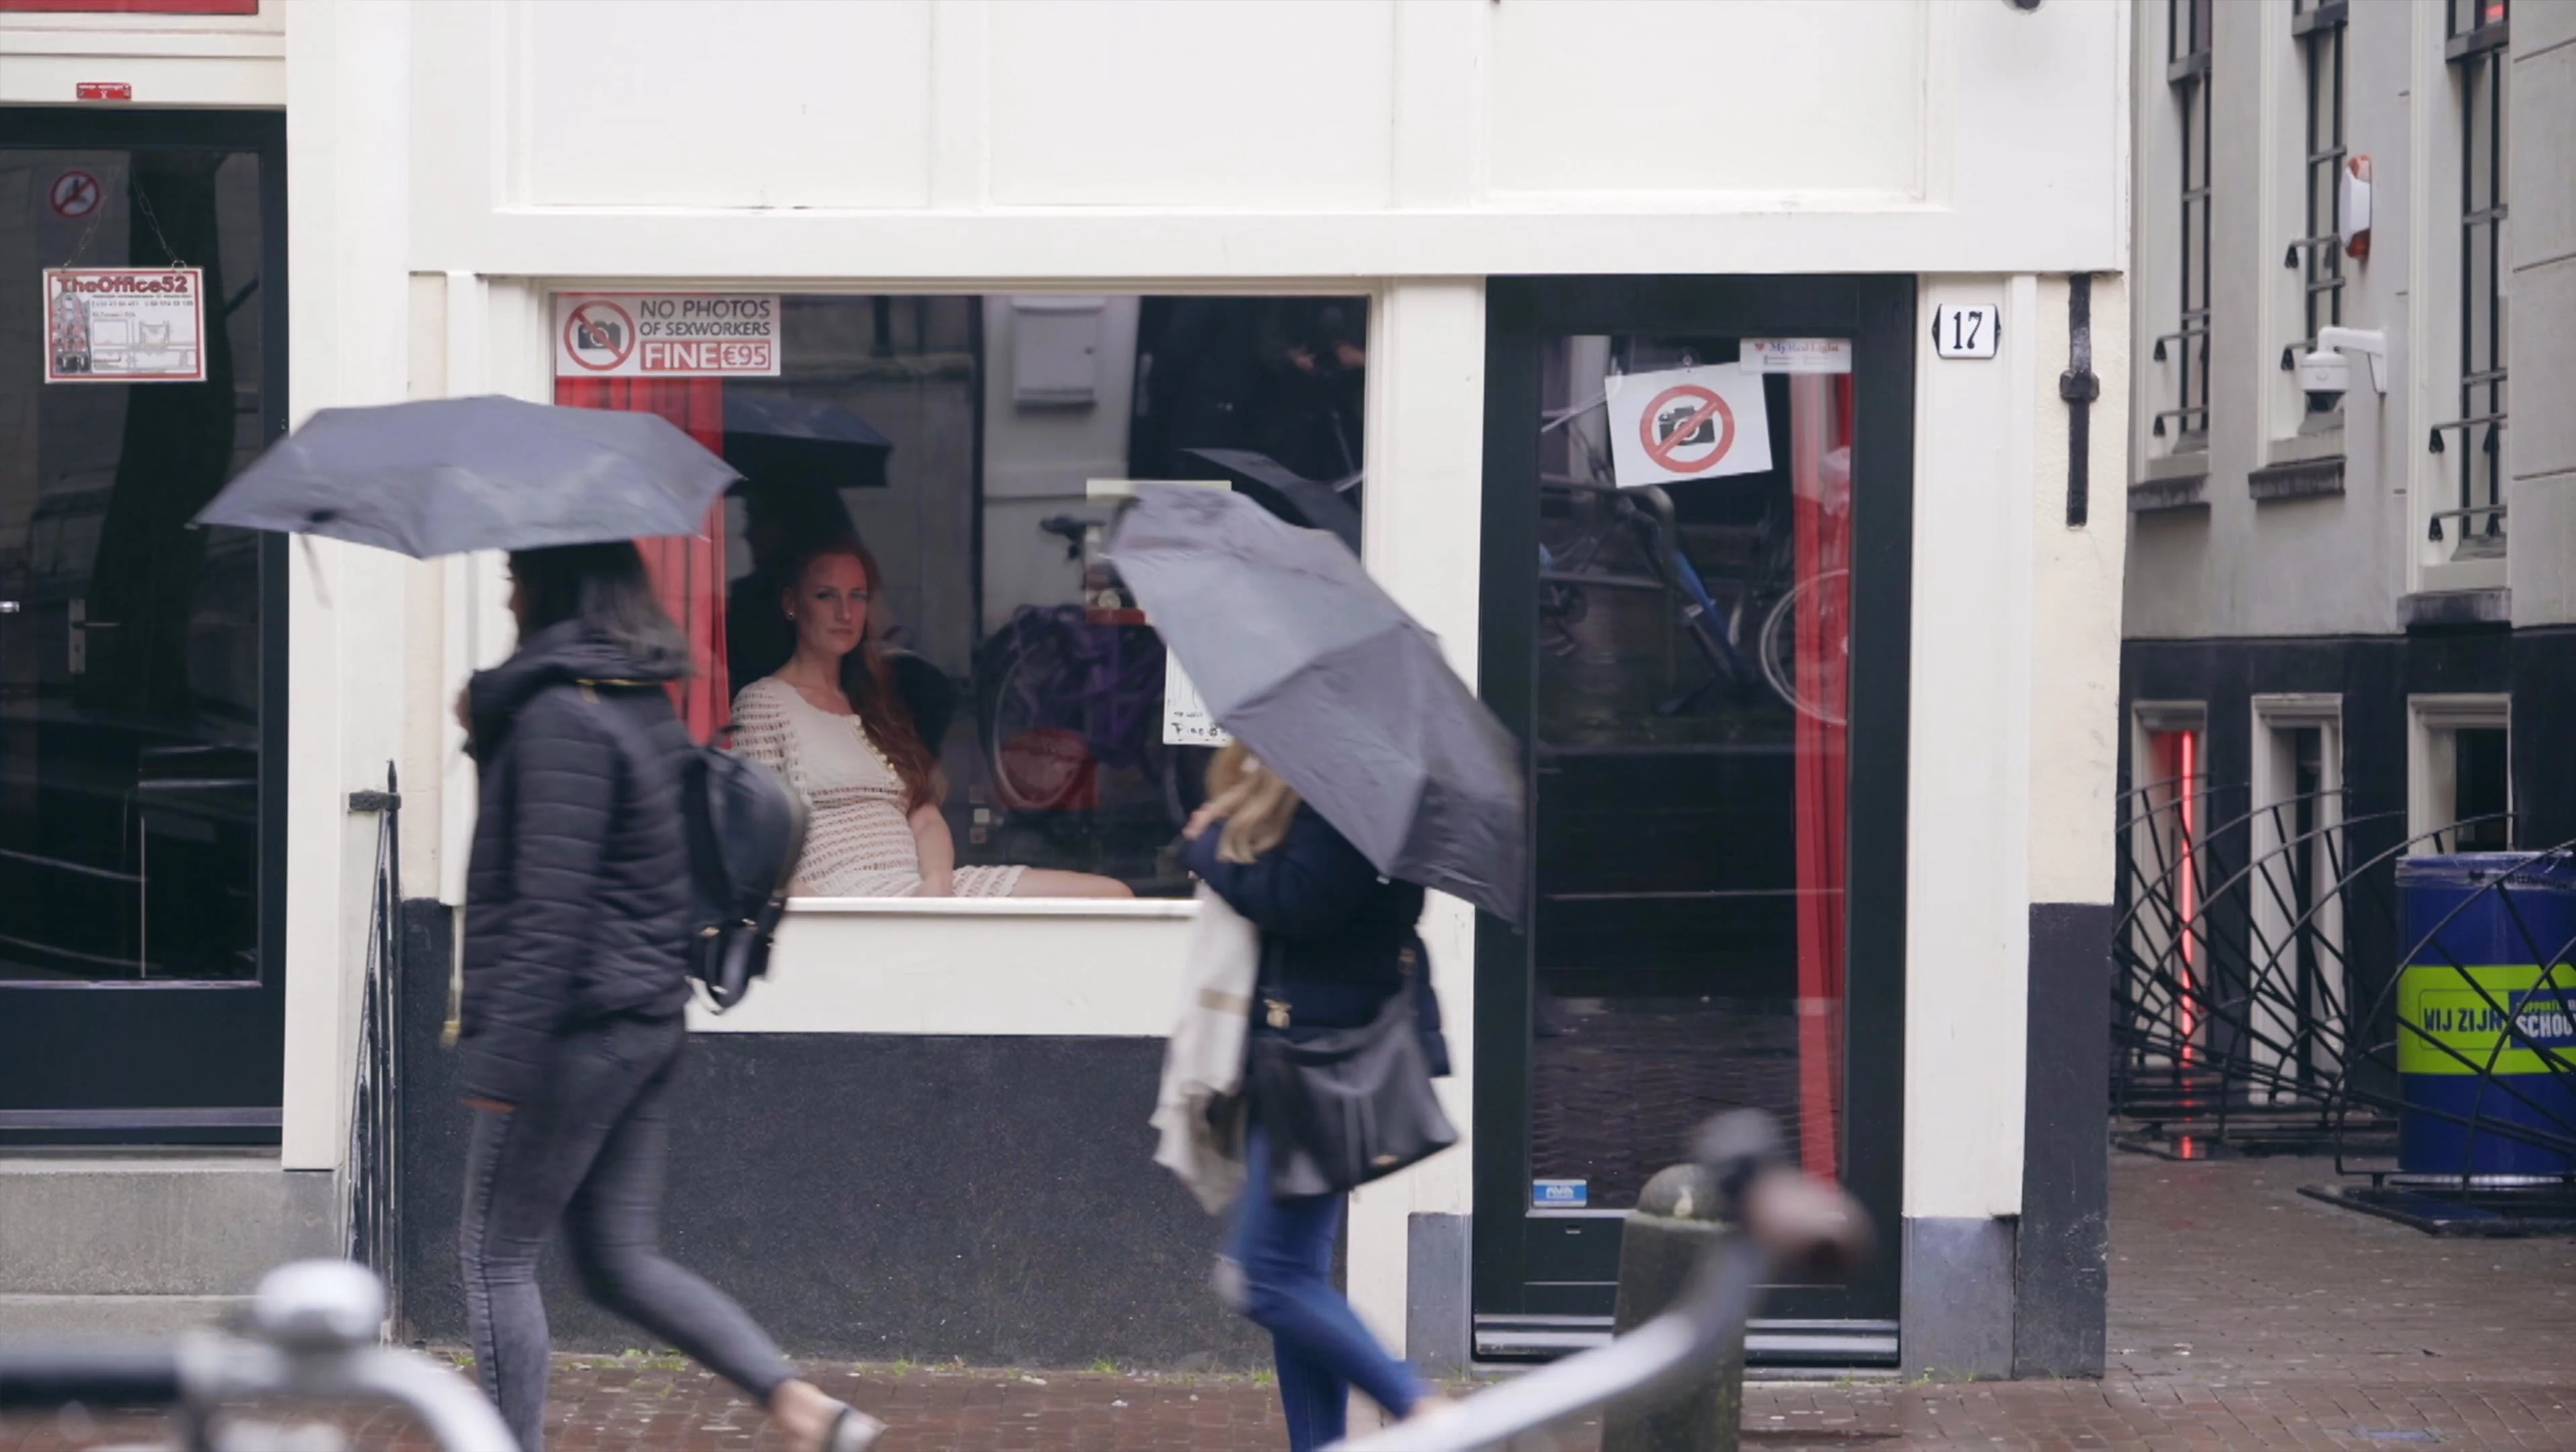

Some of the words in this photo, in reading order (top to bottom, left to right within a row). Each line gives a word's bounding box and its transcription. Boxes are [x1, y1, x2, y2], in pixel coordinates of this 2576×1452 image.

[57, 276, 188, 292] TheOffice52
[641, 300, 675, 319] NO
[682, 300, 770, 319] PHOTOS
[639, 321, 661, 335] OF
[666, 321, 770, 336] SEXWORKERS
[1953, 311, 1982, 350] 17
[645, 344, 719, 368] FINE
[723, 346, 767, 366] €95
[2424, 1008, 2452, 1032] WIJ
[2458, 1007, 2502, 1033] ZIJN
